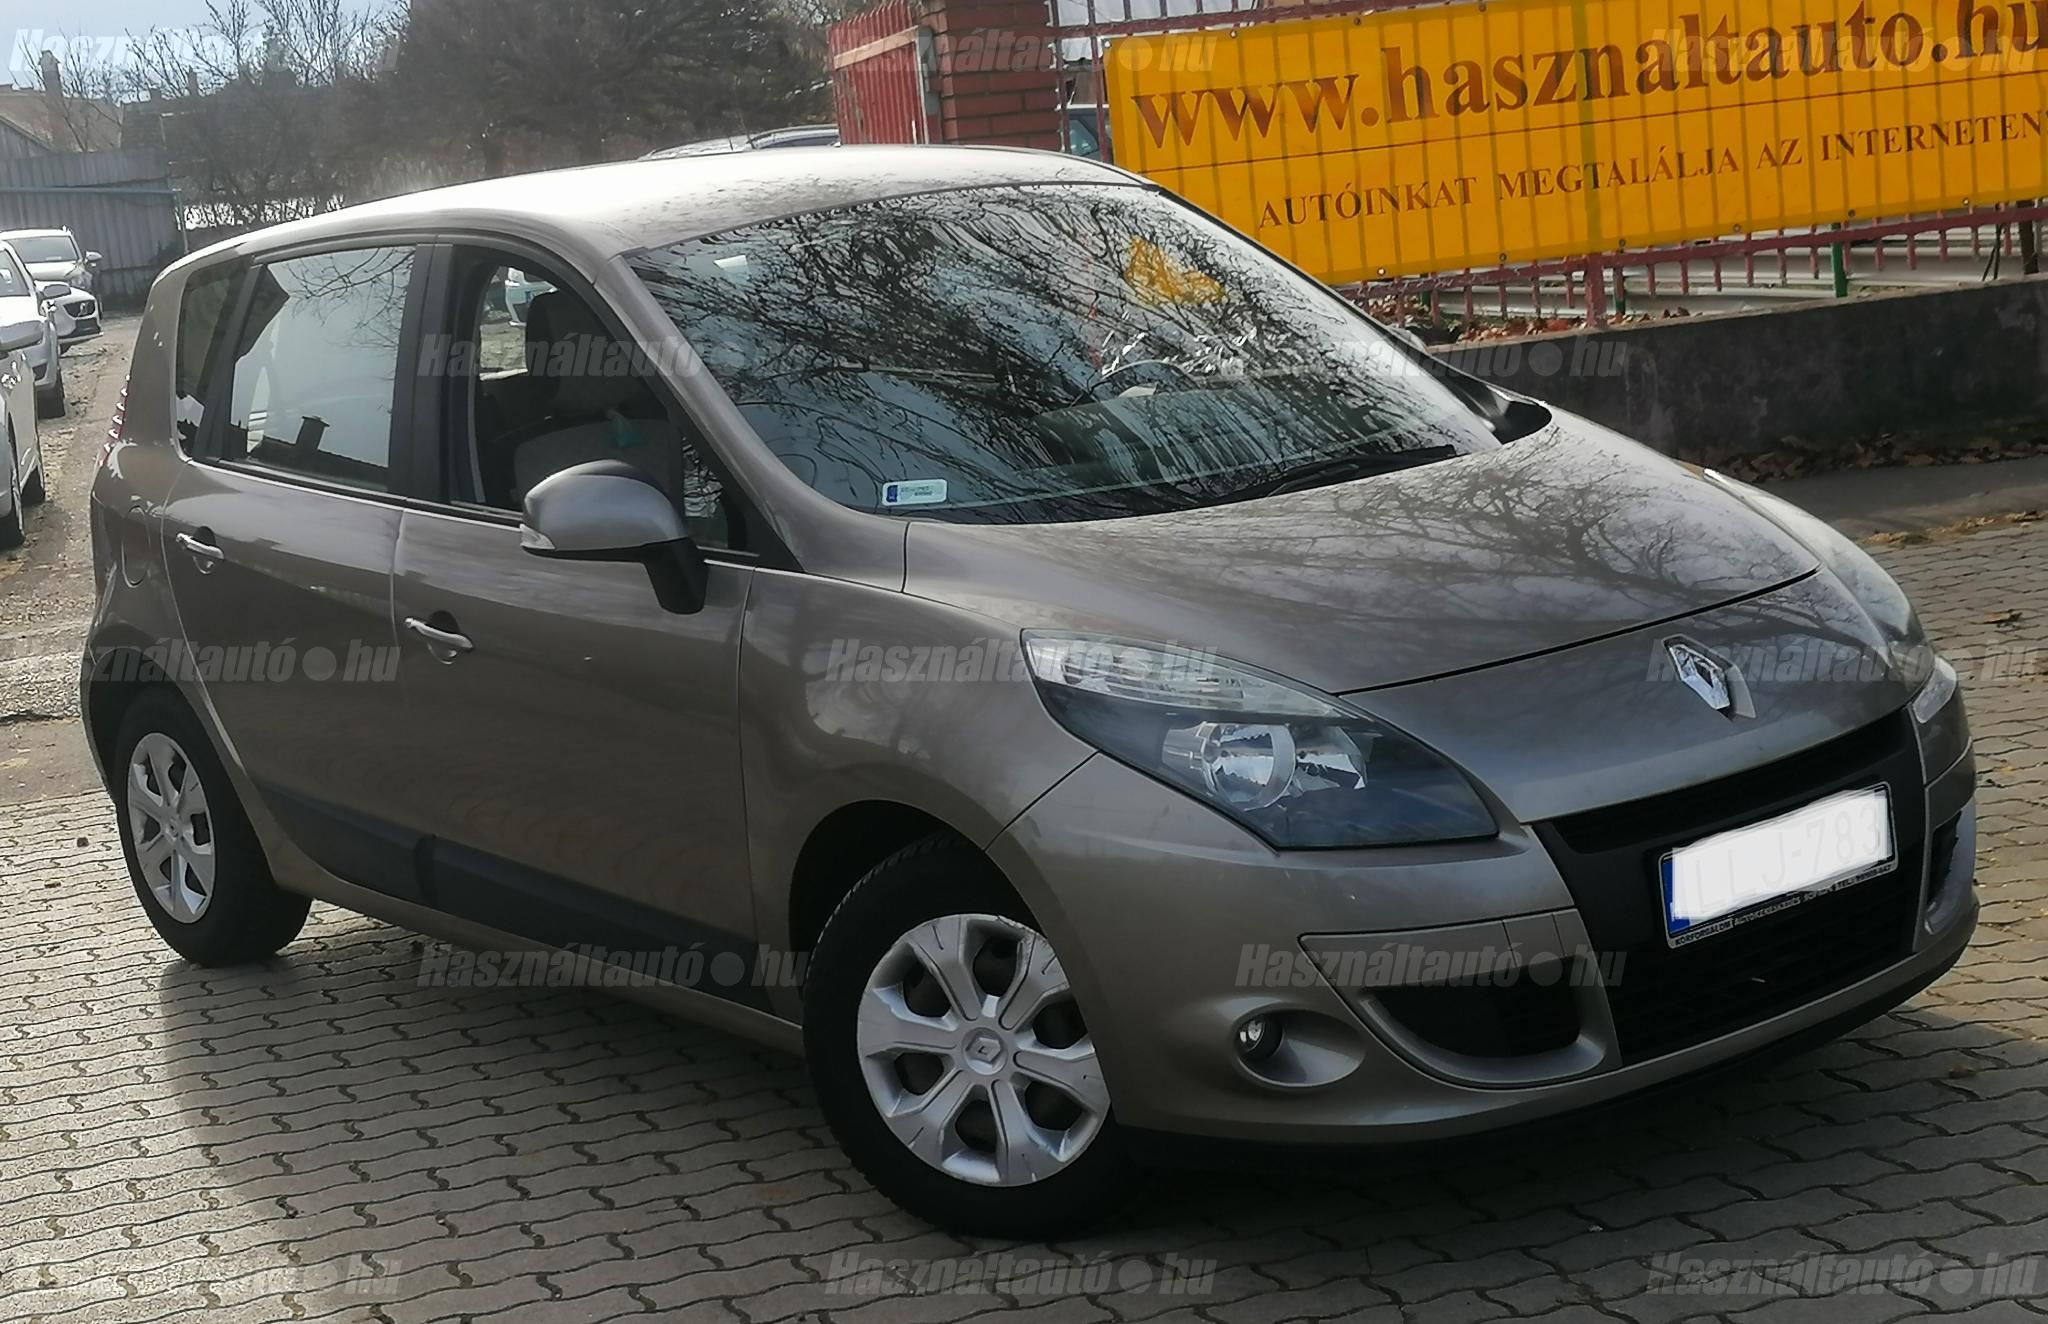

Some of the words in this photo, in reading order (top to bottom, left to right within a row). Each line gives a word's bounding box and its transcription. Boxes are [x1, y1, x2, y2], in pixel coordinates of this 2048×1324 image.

[1131, 0, 2048, 149] www.hasznaltauto.hu
[1259, 176, 1477, 228] AUTÓINKAT
[1498, 145, 1740, 200] MEGTALÁLJA
[1756, 138, 1803, 169] AZ
[1820, 109, 2048, 161] INTERNETEN
